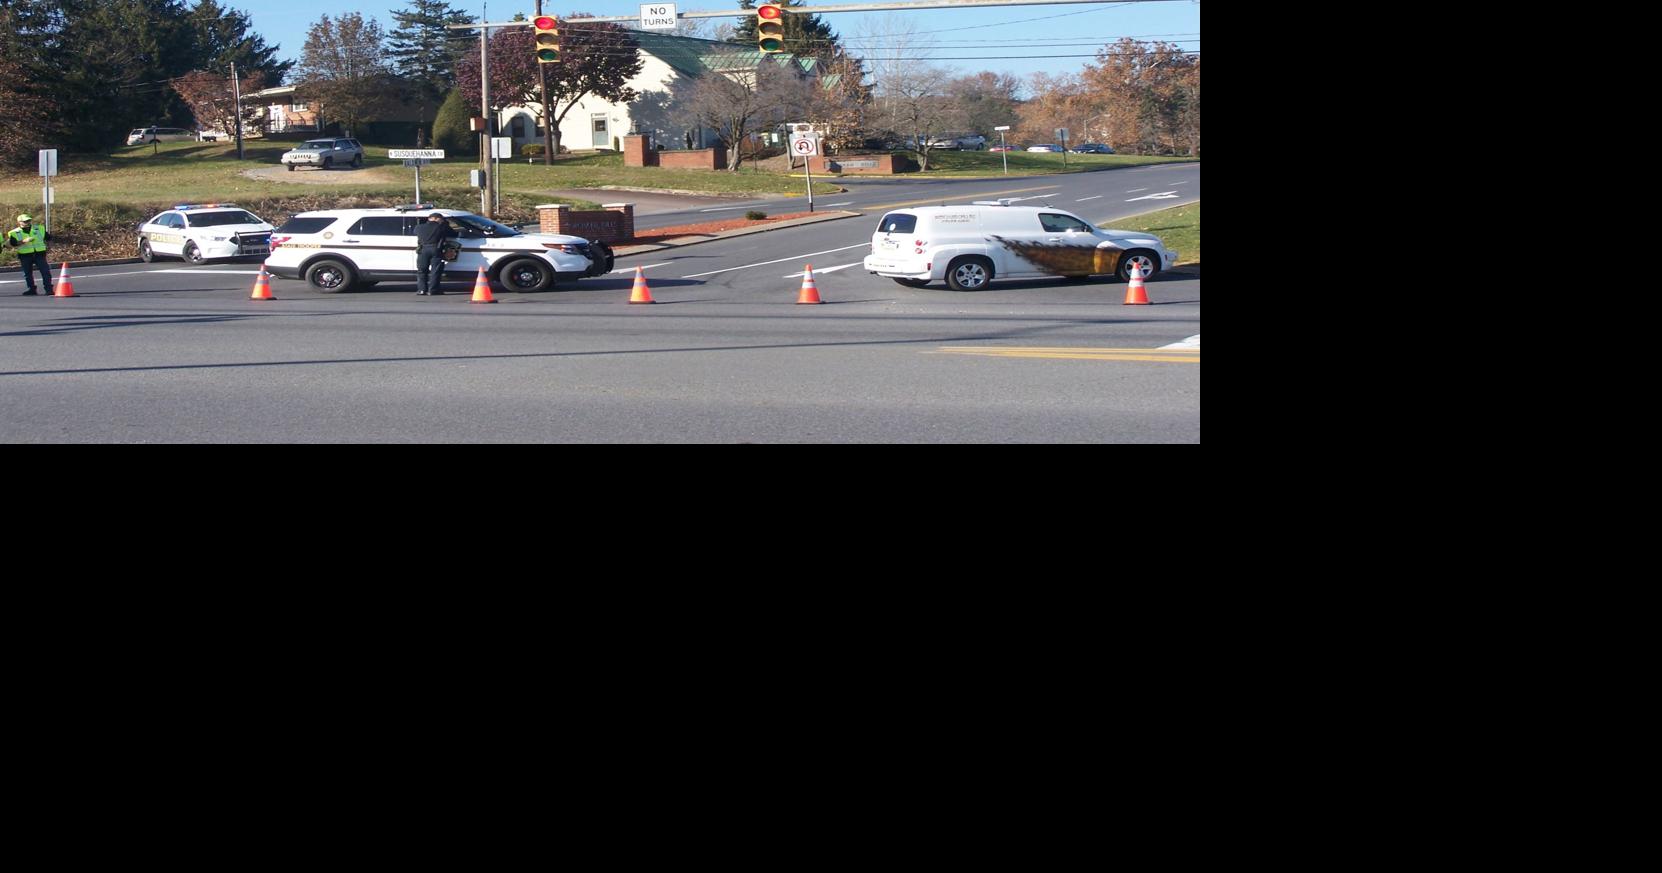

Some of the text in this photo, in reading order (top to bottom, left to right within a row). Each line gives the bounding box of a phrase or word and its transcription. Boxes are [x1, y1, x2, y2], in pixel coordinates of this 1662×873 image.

[650, 7, 666, 15] NO
[643, 18, 674, 26] TURNS
[394, 150, 437, 158] SUSQUEHANNA
[150, 231, 182, 244] POLICE
